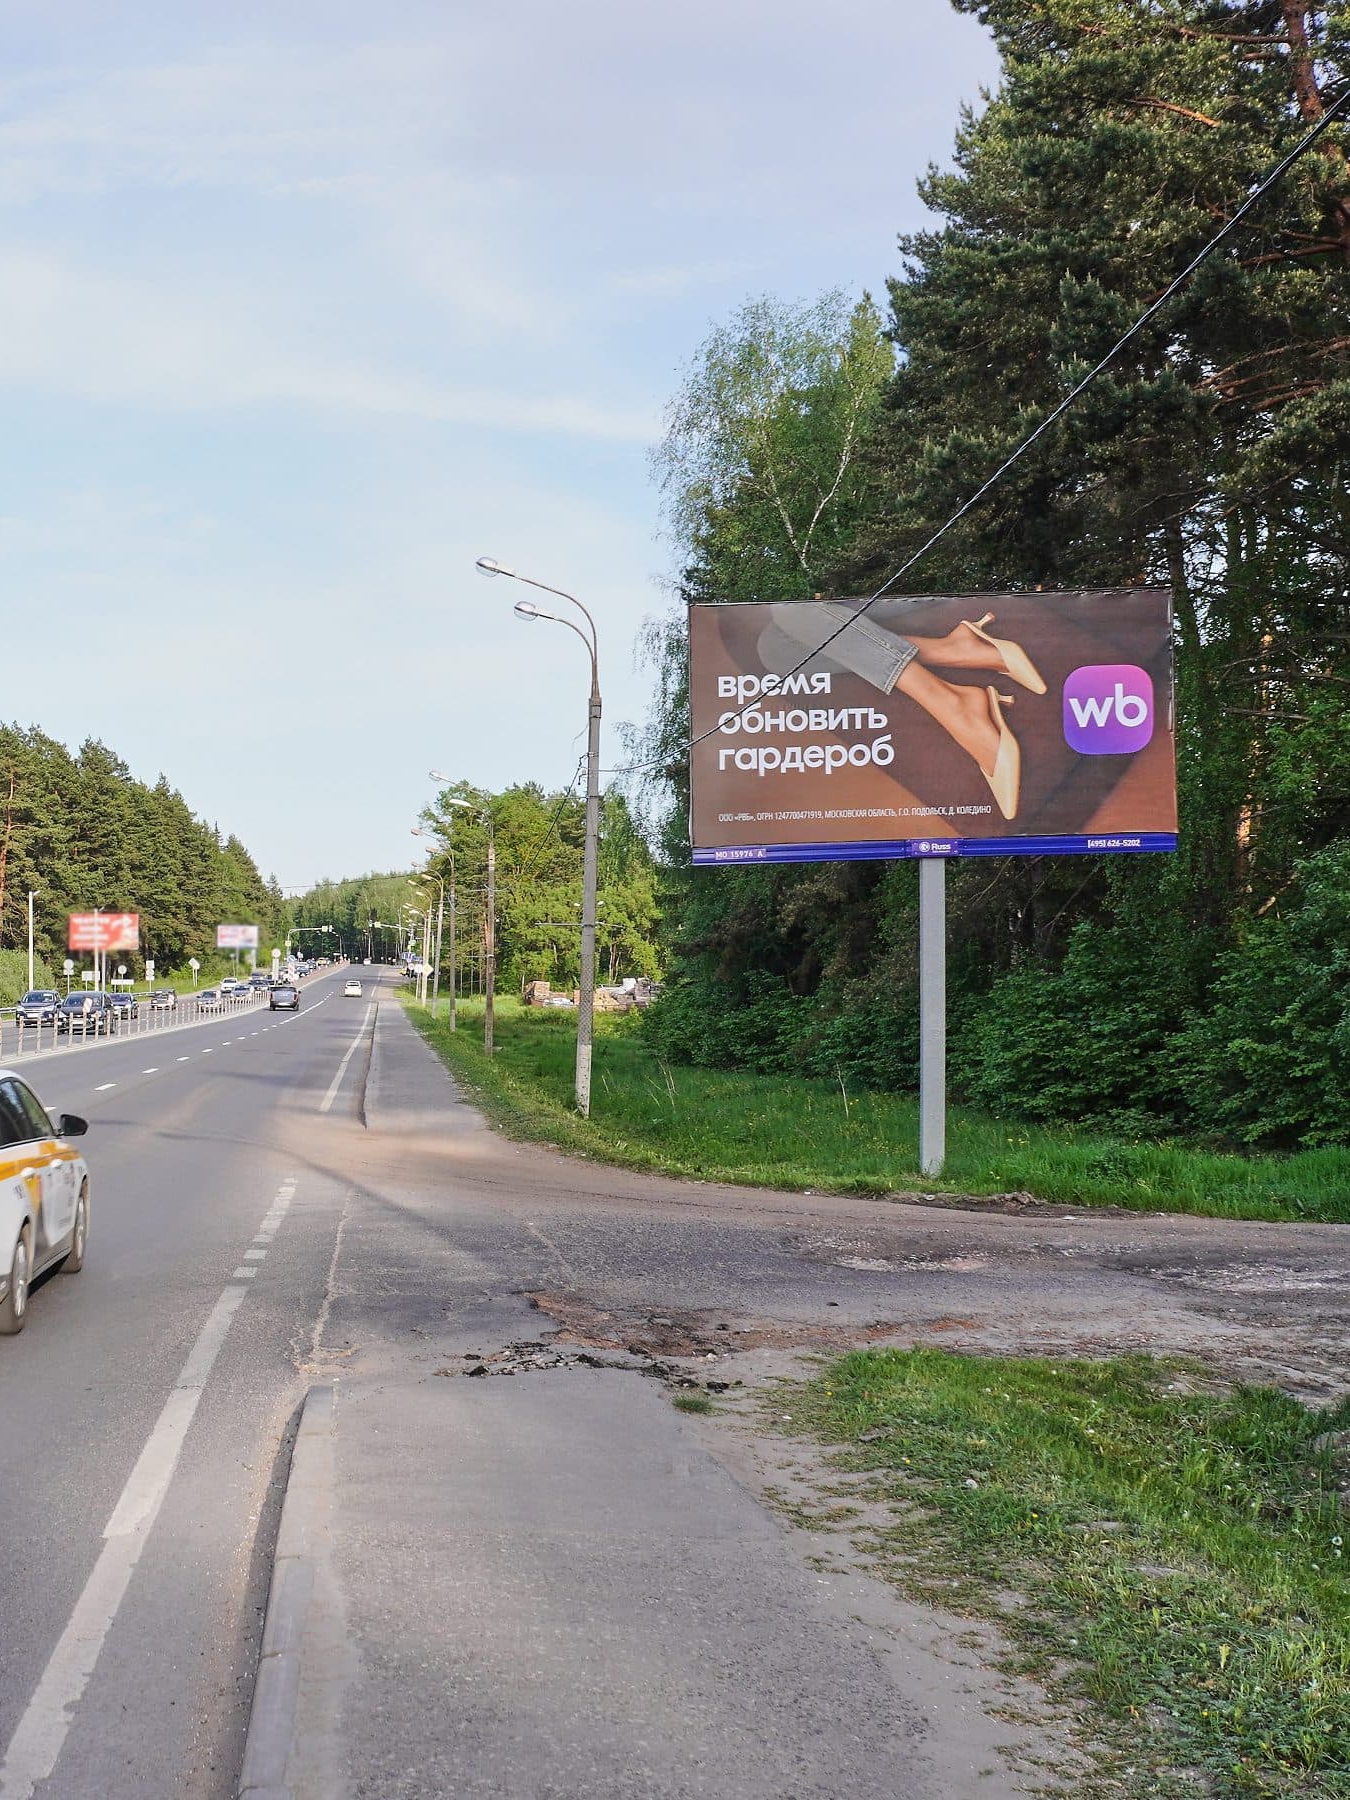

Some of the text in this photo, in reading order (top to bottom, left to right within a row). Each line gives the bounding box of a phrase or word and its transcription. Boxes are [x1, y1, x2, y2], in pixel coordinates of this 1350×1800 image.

[717, 672, 832, 705] время
[1068, 682, 1148, 728] wb
[717, 702, 889, 735] обновить
[718, 733, 896, 777] гардероб
[718, 813, 734, 822] ООО
[756, 811, 773, 821] ОГРН
[824, 808, 867, 819] МОСКОВСКАЯ
[867, 807, 898, 818] ОБЛАСТЬ,
[956, 804, 992, 815] КОЛЕДИНО
[931, 843, 952, 851] Russ
